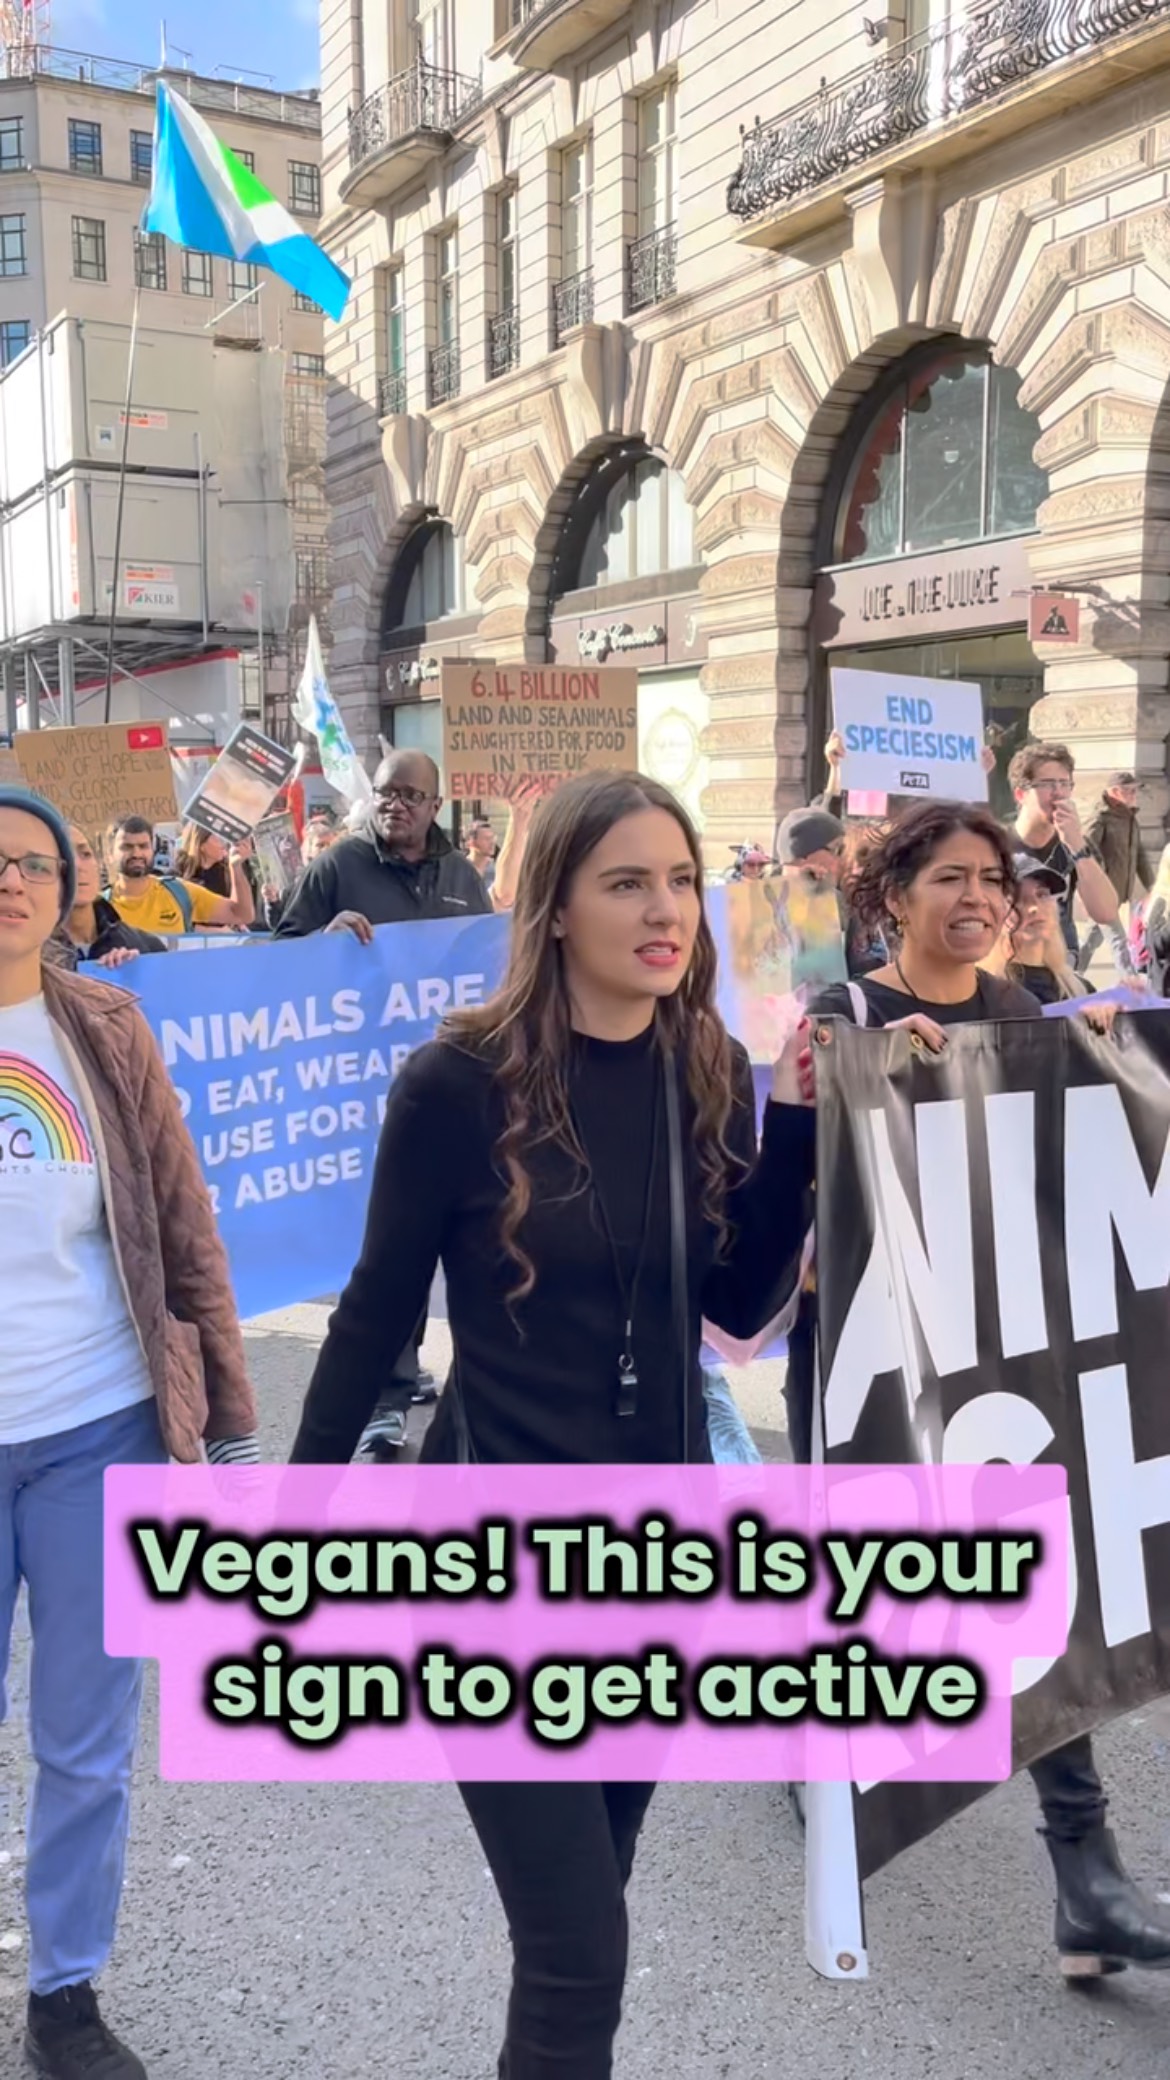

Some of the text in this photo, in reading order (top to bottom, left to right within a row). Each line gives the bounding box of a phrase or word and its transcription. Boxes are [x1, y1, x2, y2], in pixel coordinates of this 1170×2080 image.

[144, 592, 174, 606] KIER
[471, 670, 515, 702] 6.4
[520, 670, 600, 701] BILLION
[446, 705, 493, 726] LAND
[498, 704, 532, 726] AND
[886, 695, 933, 725] END
[53, 731, 110, 756] WATCH
[450, 730, 626, 751] SLAUGHTERED FOR FOOD
[844, 724, 976, 762] SPECIESISM
[73, 756, 92, 777] OF
[101, 751, 141, 774] HOPE
[491, 752, 588, 772] IN THE UK
[450, 772, 515, 798] EVERY
[160, 973, 485, 1066] NIMALS ARE
[208, 1067, 284, 1115] EAT,
[203, 1118, 275, 1167] USE
[286, 1100, 367, 1145] FOR
[234, 1147, 363, 1209] ABUSE
